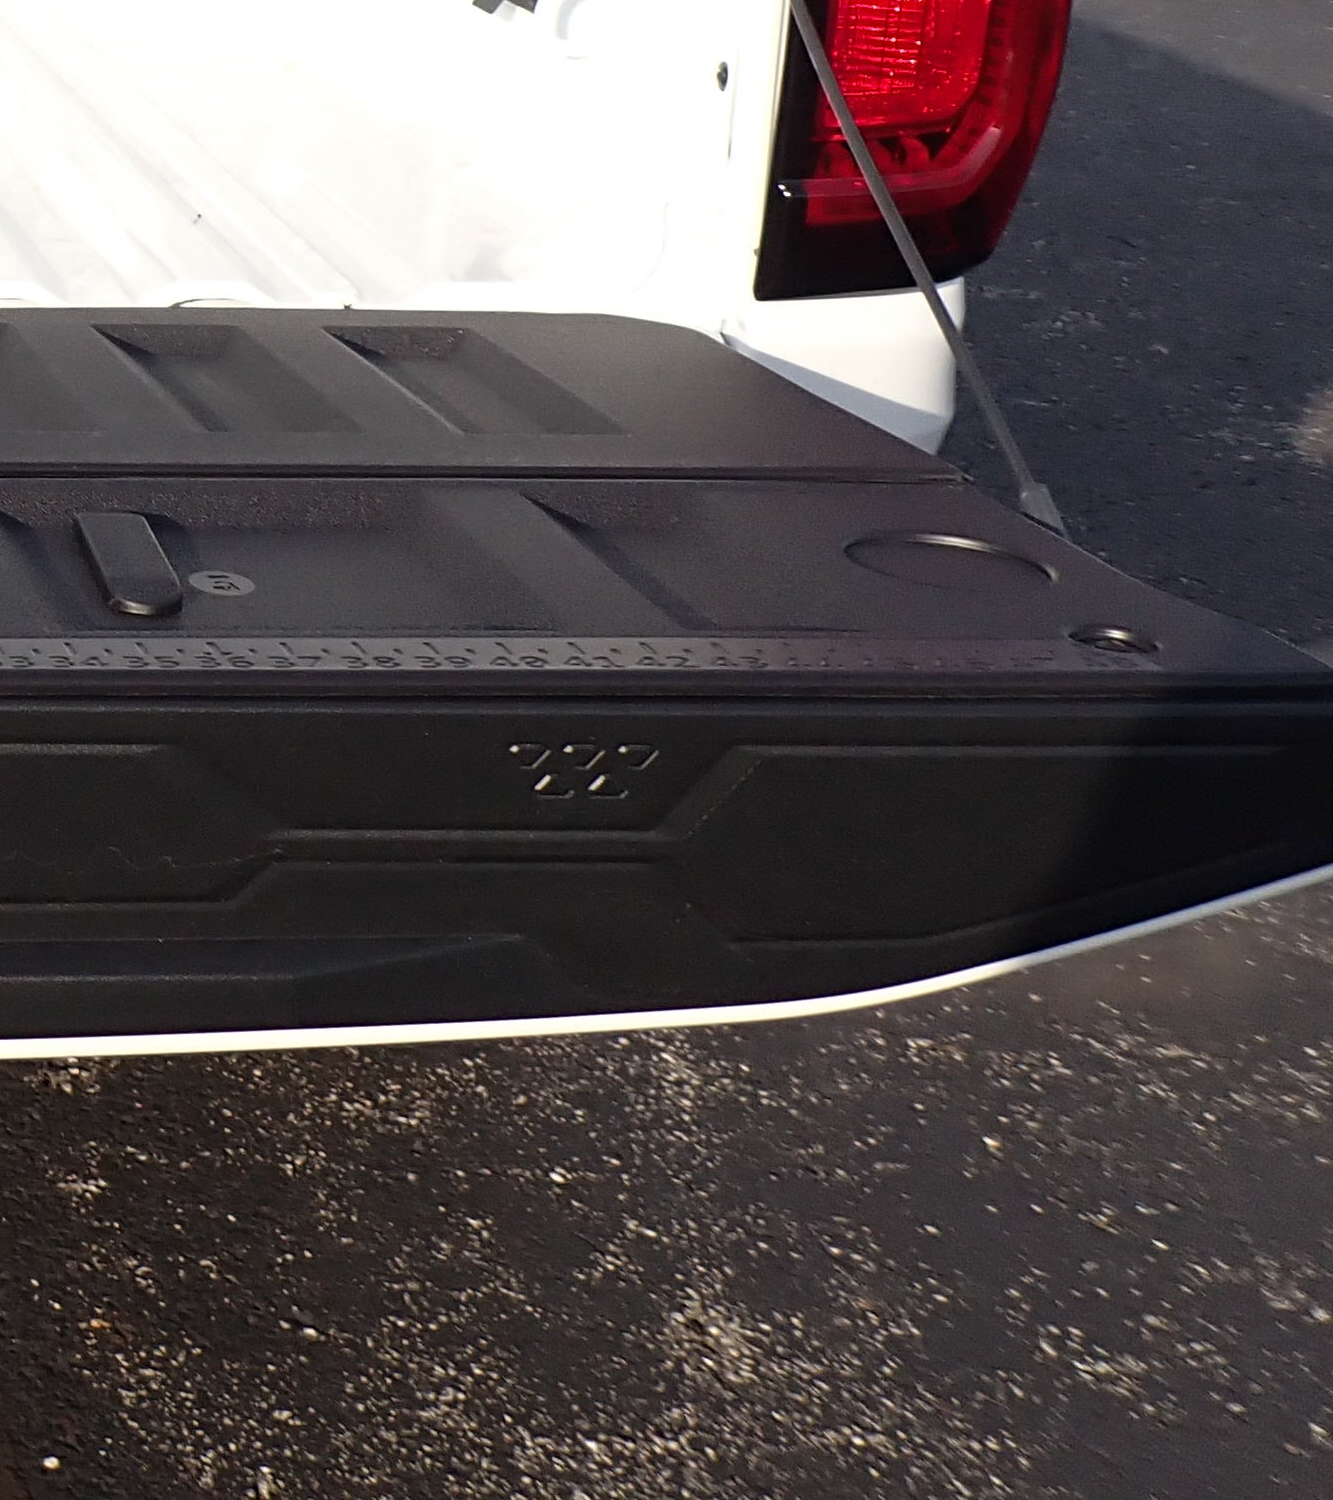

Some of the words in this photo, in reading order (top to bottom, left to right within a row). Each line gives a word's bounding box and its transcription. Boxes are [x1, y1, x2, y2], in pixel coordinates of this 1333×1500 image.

[48, 655, 109, 668] 34
[121, 655, 181, 668] 35
[194, 655, 255, 668] 36
[267, 656, 322, 668] 37
[339, 655, 402, 668] 38
[413, 655, 473, 668] 39
[488, 655, 550, 668] 40
[563, 655, 626, 668] 41
[636, 655, 702, 668] 42
